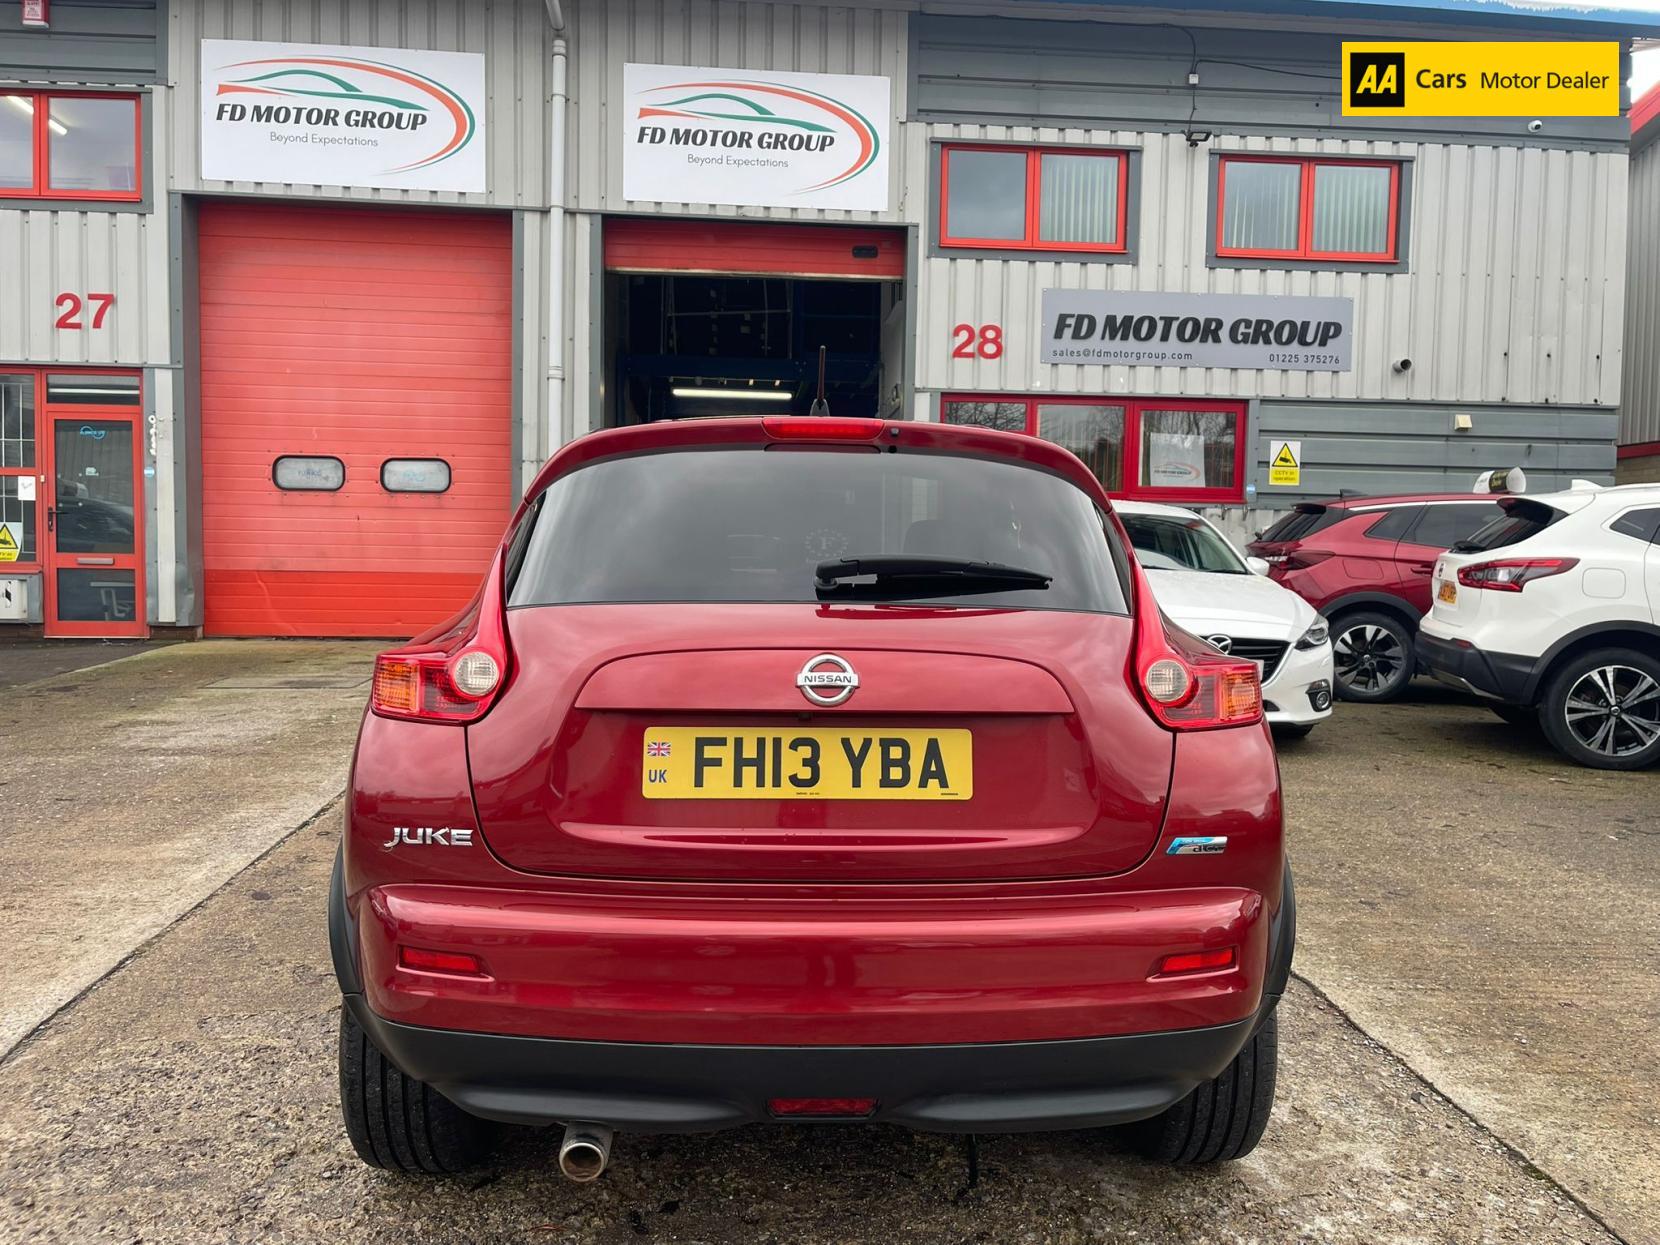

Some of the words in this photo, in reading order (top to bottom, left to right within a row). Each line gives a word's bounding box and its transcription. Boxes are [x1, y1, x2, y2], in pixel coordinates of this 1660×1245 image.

[216, 103, 247, 122] FD
[250, 106, 340, 127] MOTOR
[344, 110, 428, 131] GROUP
[270, 131, 308, 145] Beyond
[311, 133, 378, 147] Expectations
[637, 126, 666, 145] FD
[669, 128, 753, 149] MOTOR
[757, 132, 835, 152] GROUP
[687, 154, 723, 167] Beyond
[726, 156, 789, 169] Expectations
[55, 292, 115, 330] 27
[1053, 313, 1097, 340] FD
[1101, 314, 1224, 344] MOTOR
[1228, 318, 1343, 348] GROUP
[952, 324, 1003, 360] 28
[1052, 347, 1193, 361] sales@fdmotorgroup.com
[1269, 353, 1300, 364] 01225
[1303, 354, 1340, 365] 375276
[804, 675, 852, 683] NISSAN
[694, 736, 821, 788] FH13
[840, 737, 949, 789] YBA
[648, 769, 668, 784] UK
[383, 827, 474, 848] JUKE
